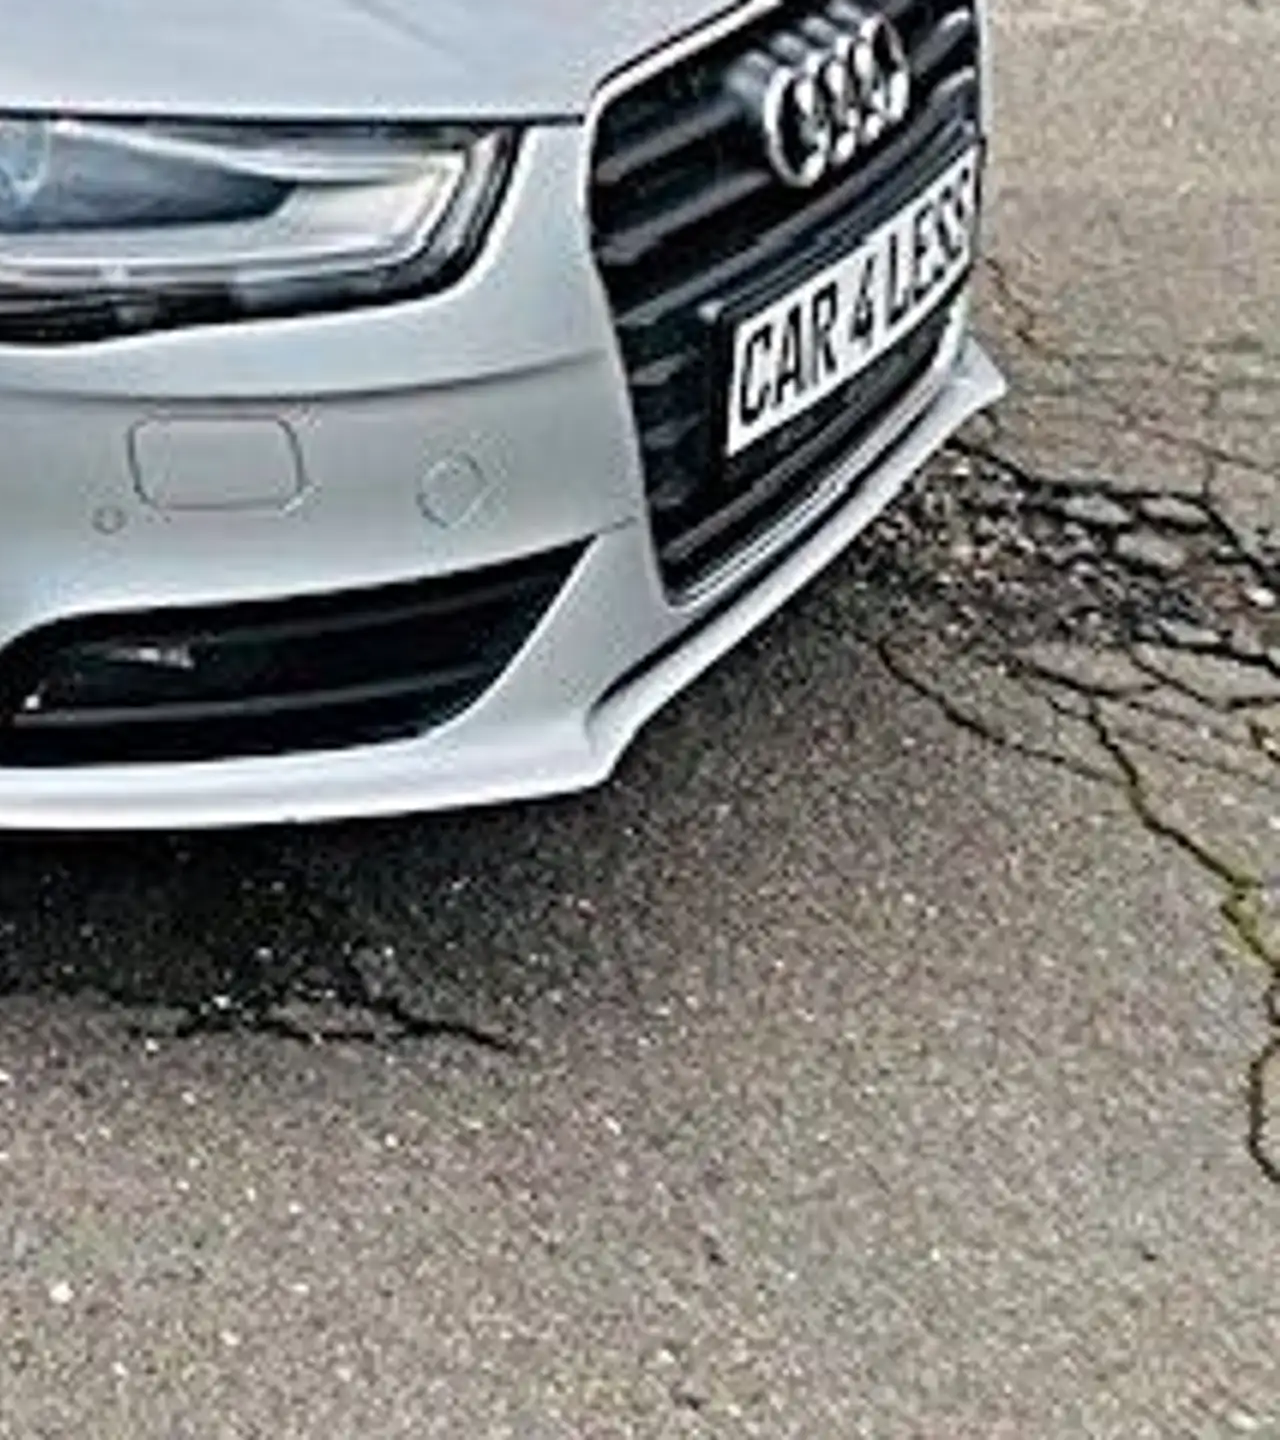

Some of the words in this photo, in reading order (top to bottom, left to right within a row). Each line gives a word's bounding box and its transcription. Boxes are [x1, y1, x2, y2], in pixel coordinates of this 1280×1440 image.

[740, 281, 838, 427] CAR
[848, 253, 875, 348] 4
[886, 165, 972, 330] LESS
